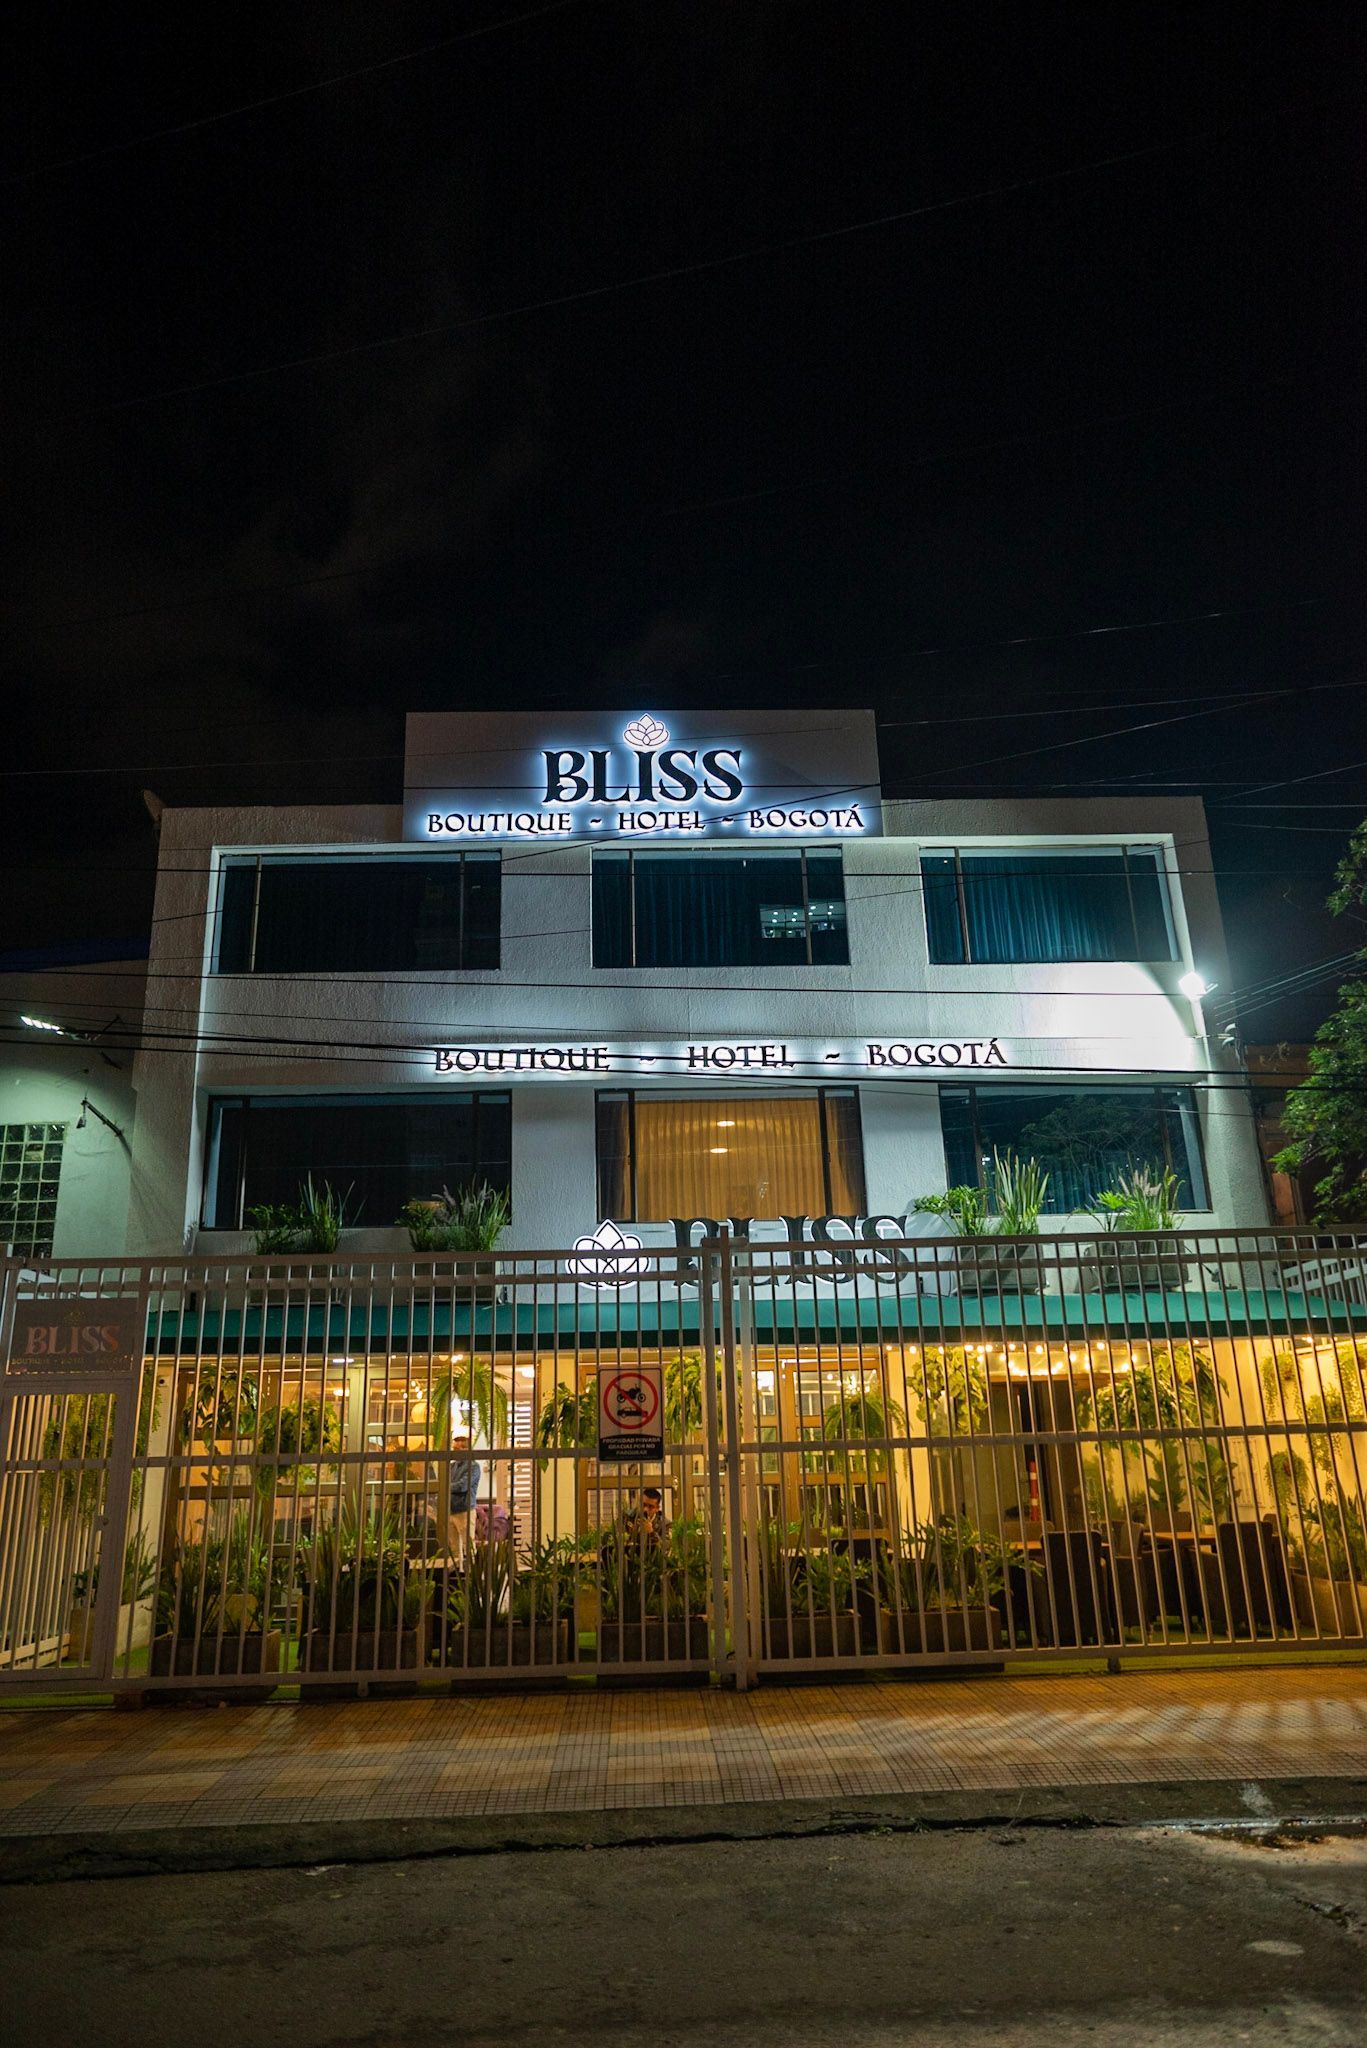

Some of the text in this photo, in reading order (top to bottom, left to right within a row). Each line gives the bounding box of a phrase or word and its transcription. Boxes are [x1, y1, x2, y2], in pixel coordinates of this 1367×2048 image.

[541, 749, 743, 803] BLISS
[427, 812, 572, 834] BOUTIQUE
[618, 810, 706, 832] HOTEL
[749, 803, 864, 829] BOGOTÁ
[434, 1047, 610, 1072] BOUTIQUE
[687, 1045, 796, 1068] HOTEL
[867, 1038, 1007, 1066] BOGOTÁ
[25, 1325, 119, 1355] BLISS
